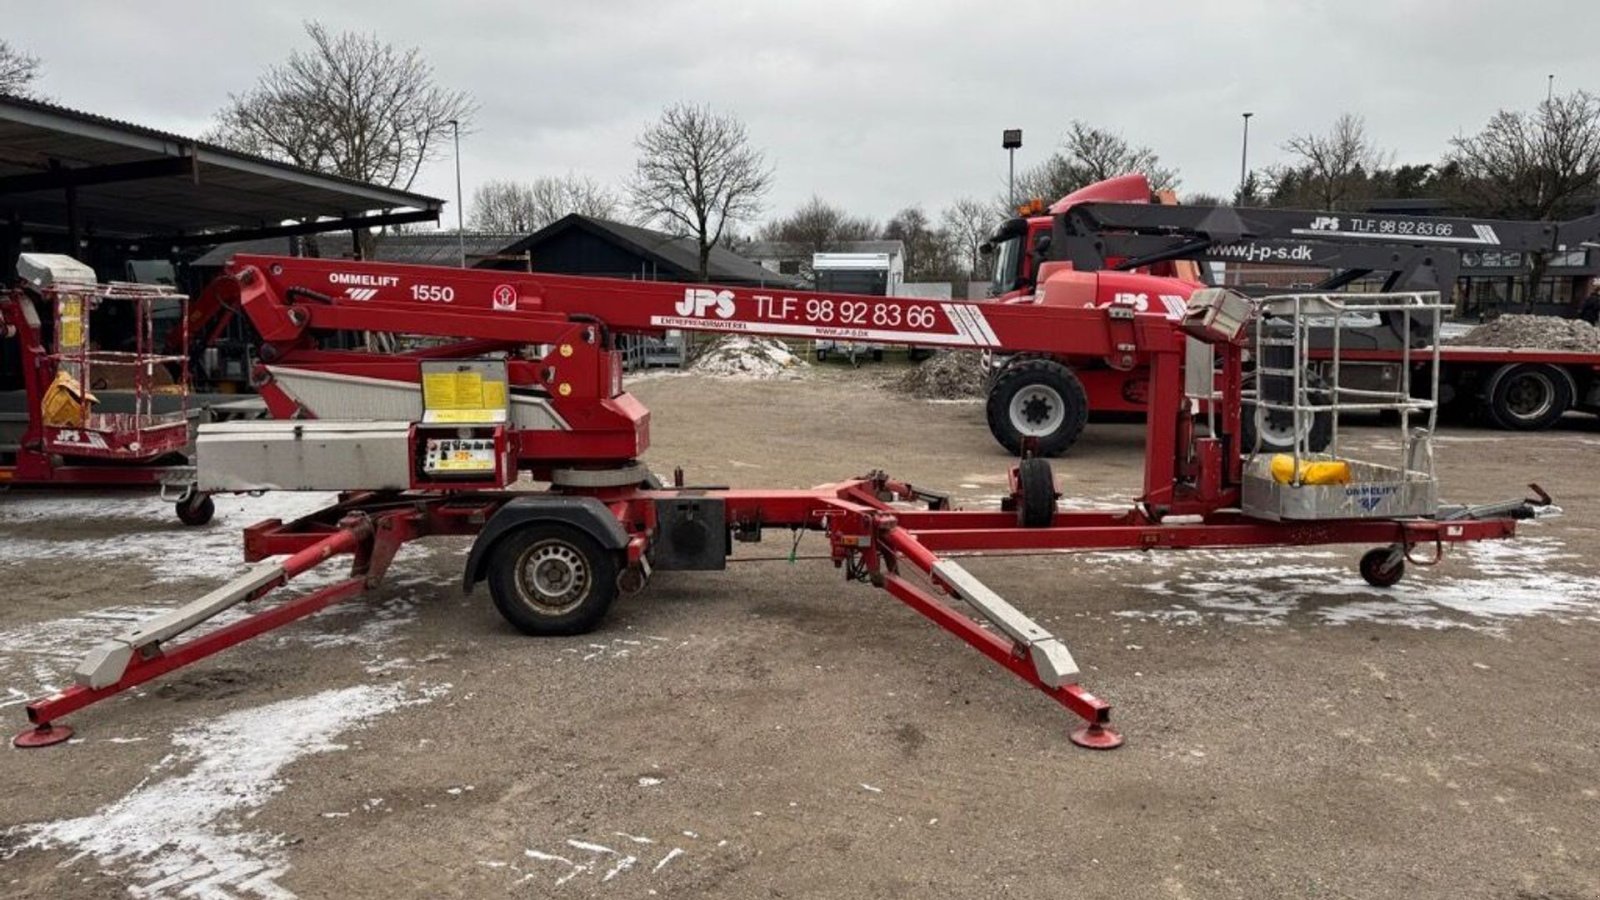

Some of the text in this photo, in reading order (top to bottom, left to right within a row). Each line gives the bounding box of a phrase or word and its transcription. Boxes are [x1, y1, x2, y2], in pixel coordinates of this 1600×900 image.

[1310, 217, 1339, 230] JPS
[1350, 219, 1452, 236] TLF. 98 92 83 66
[329, 273, 399, 287] OMMELIFT
[410, 285, 454, 302] 1550
[675, 289, 735, 318] JPS
[753, 295, 799, 320] TLF.
[806, 300, 834, 322] 98
[839, 302, 867, 325] 92
[873, 304, 901, 327] 83
[907, 306, 935, 328] 66
[57, 430, 80, 441] JPS
